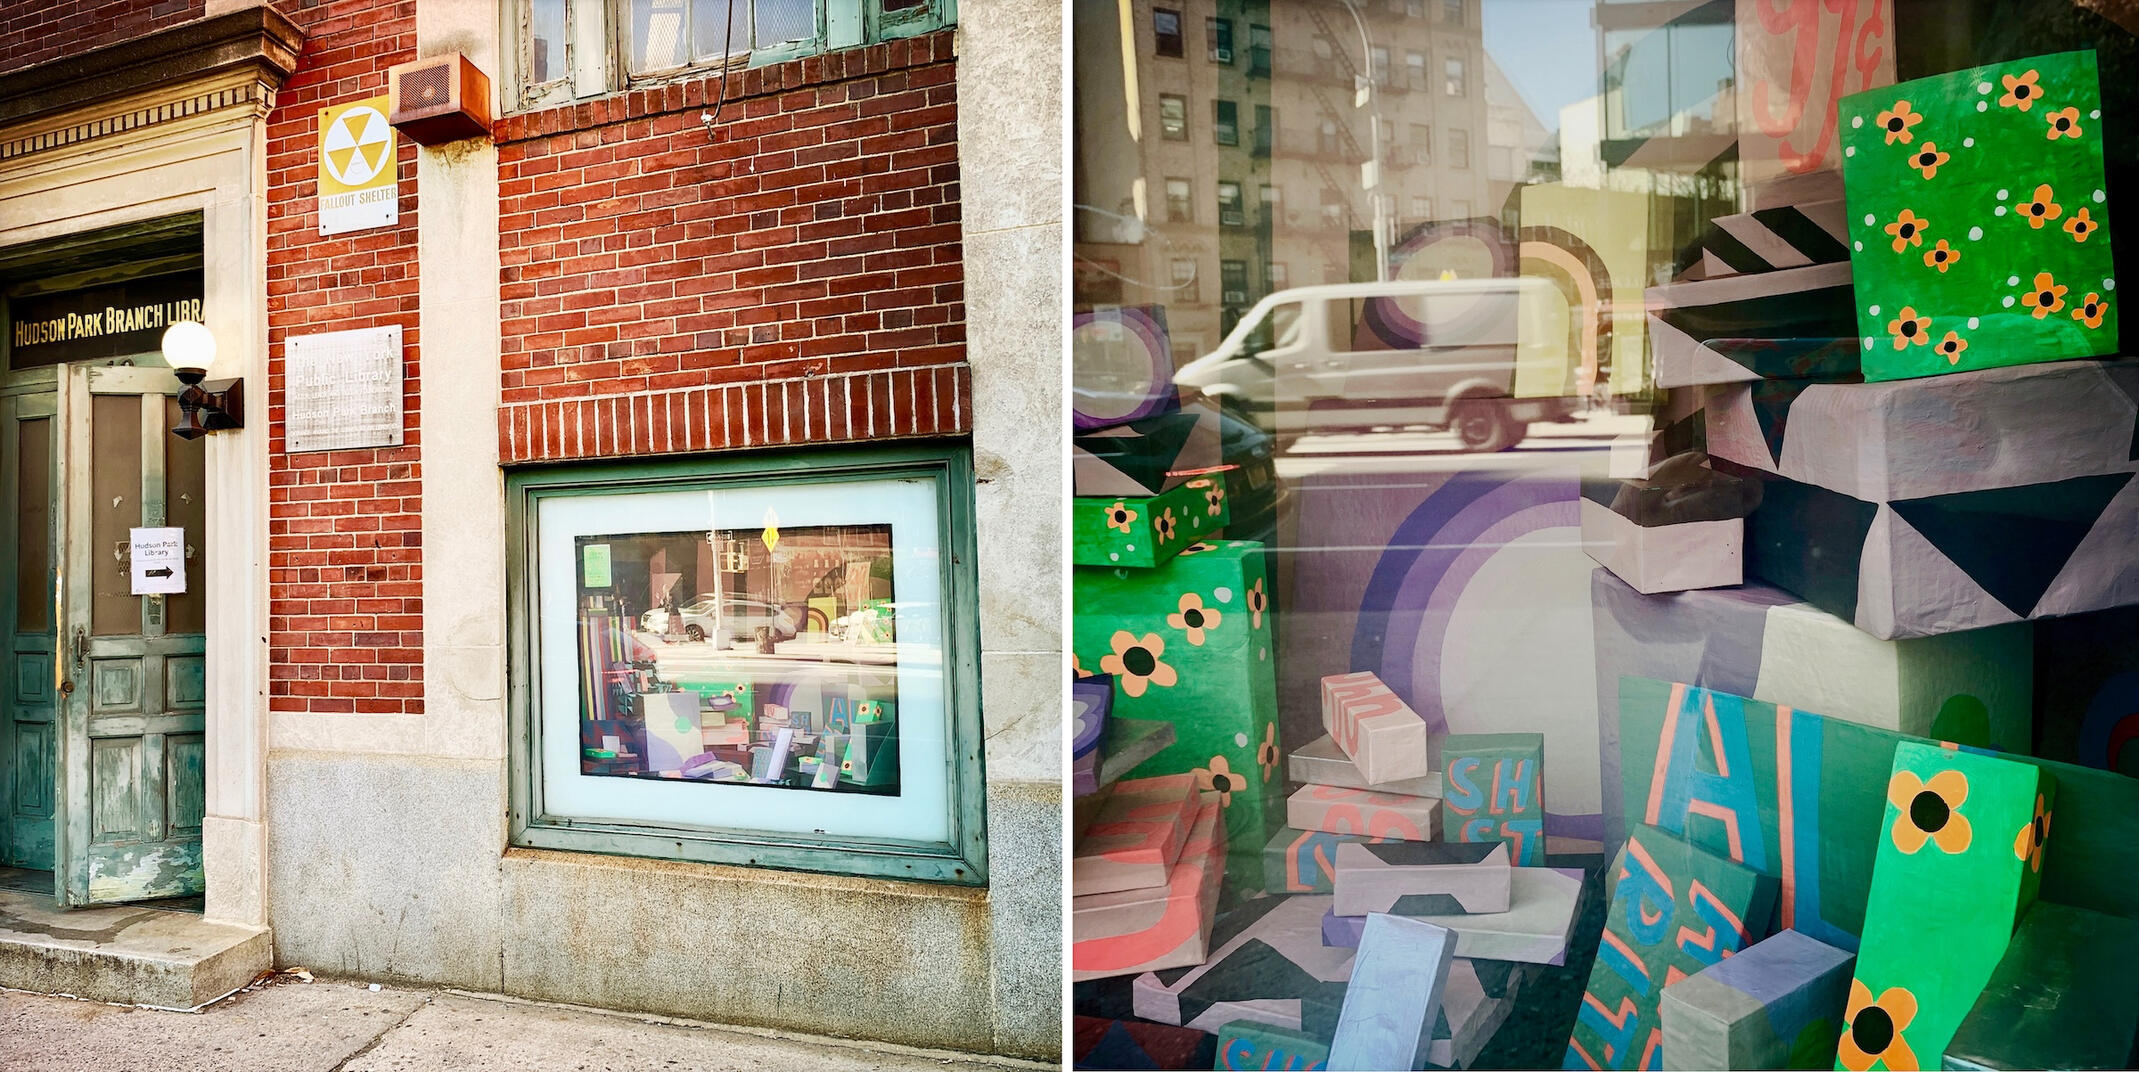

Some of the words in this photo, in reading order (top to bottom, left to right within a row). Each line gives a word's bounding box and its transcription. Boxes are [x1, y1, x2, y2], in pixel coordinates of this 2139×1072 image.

[320, 193, 356, 211] FALLOUT
[359, 187, 397, 205] SHELTER
[296, 371, 336, 388] Public
[345, 368, 392, 384] Library
[292, 408, 329, 420] Hudson
[360, 402, 396, 416] Branch
[135, 541, 161, 549] Hudson
[1445, 756, 1543, 816] SH
